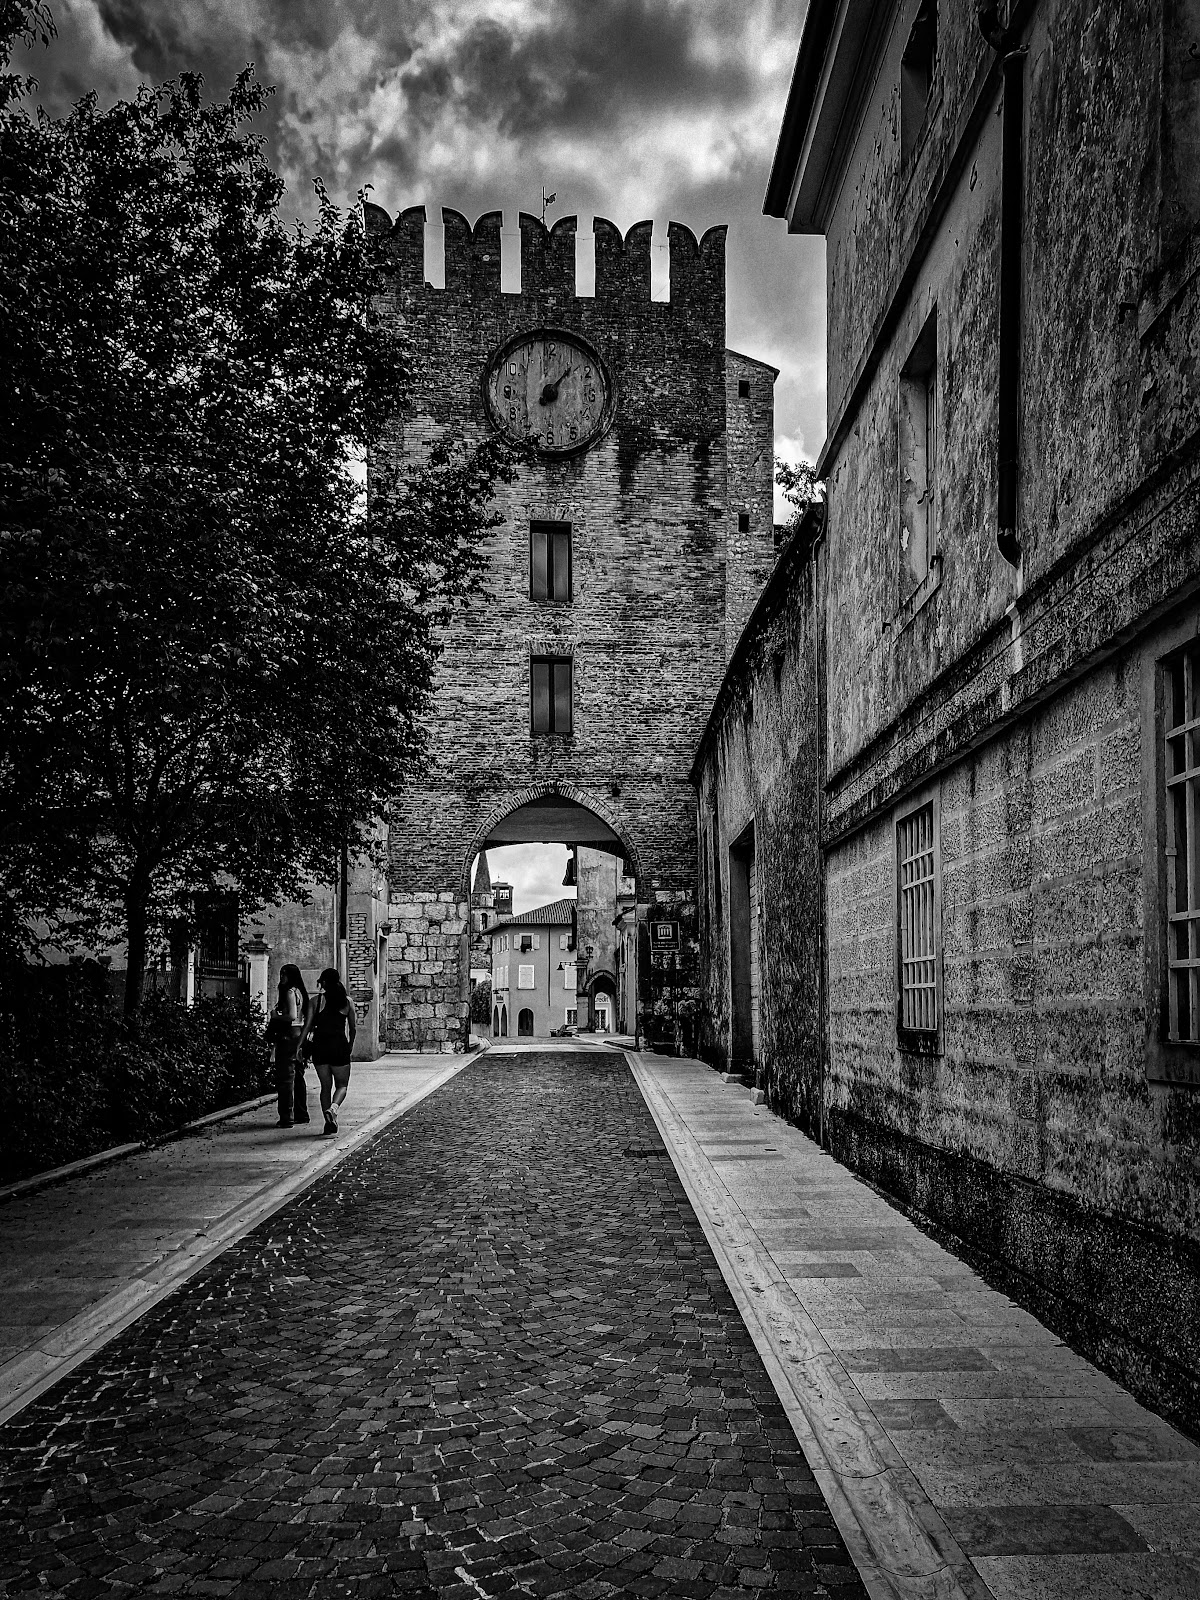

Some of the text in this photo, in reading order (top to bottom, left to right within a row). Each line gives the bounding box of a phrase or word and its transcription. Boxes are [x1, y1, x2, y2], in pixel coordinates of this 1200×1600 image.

[584, 365, 592, 379] 2
[503, 385, 512, 400] 9
[509, 406, 517, 421] 8
[546, 431, 554, 445] 6
[569, 426, 577, 440] 5
